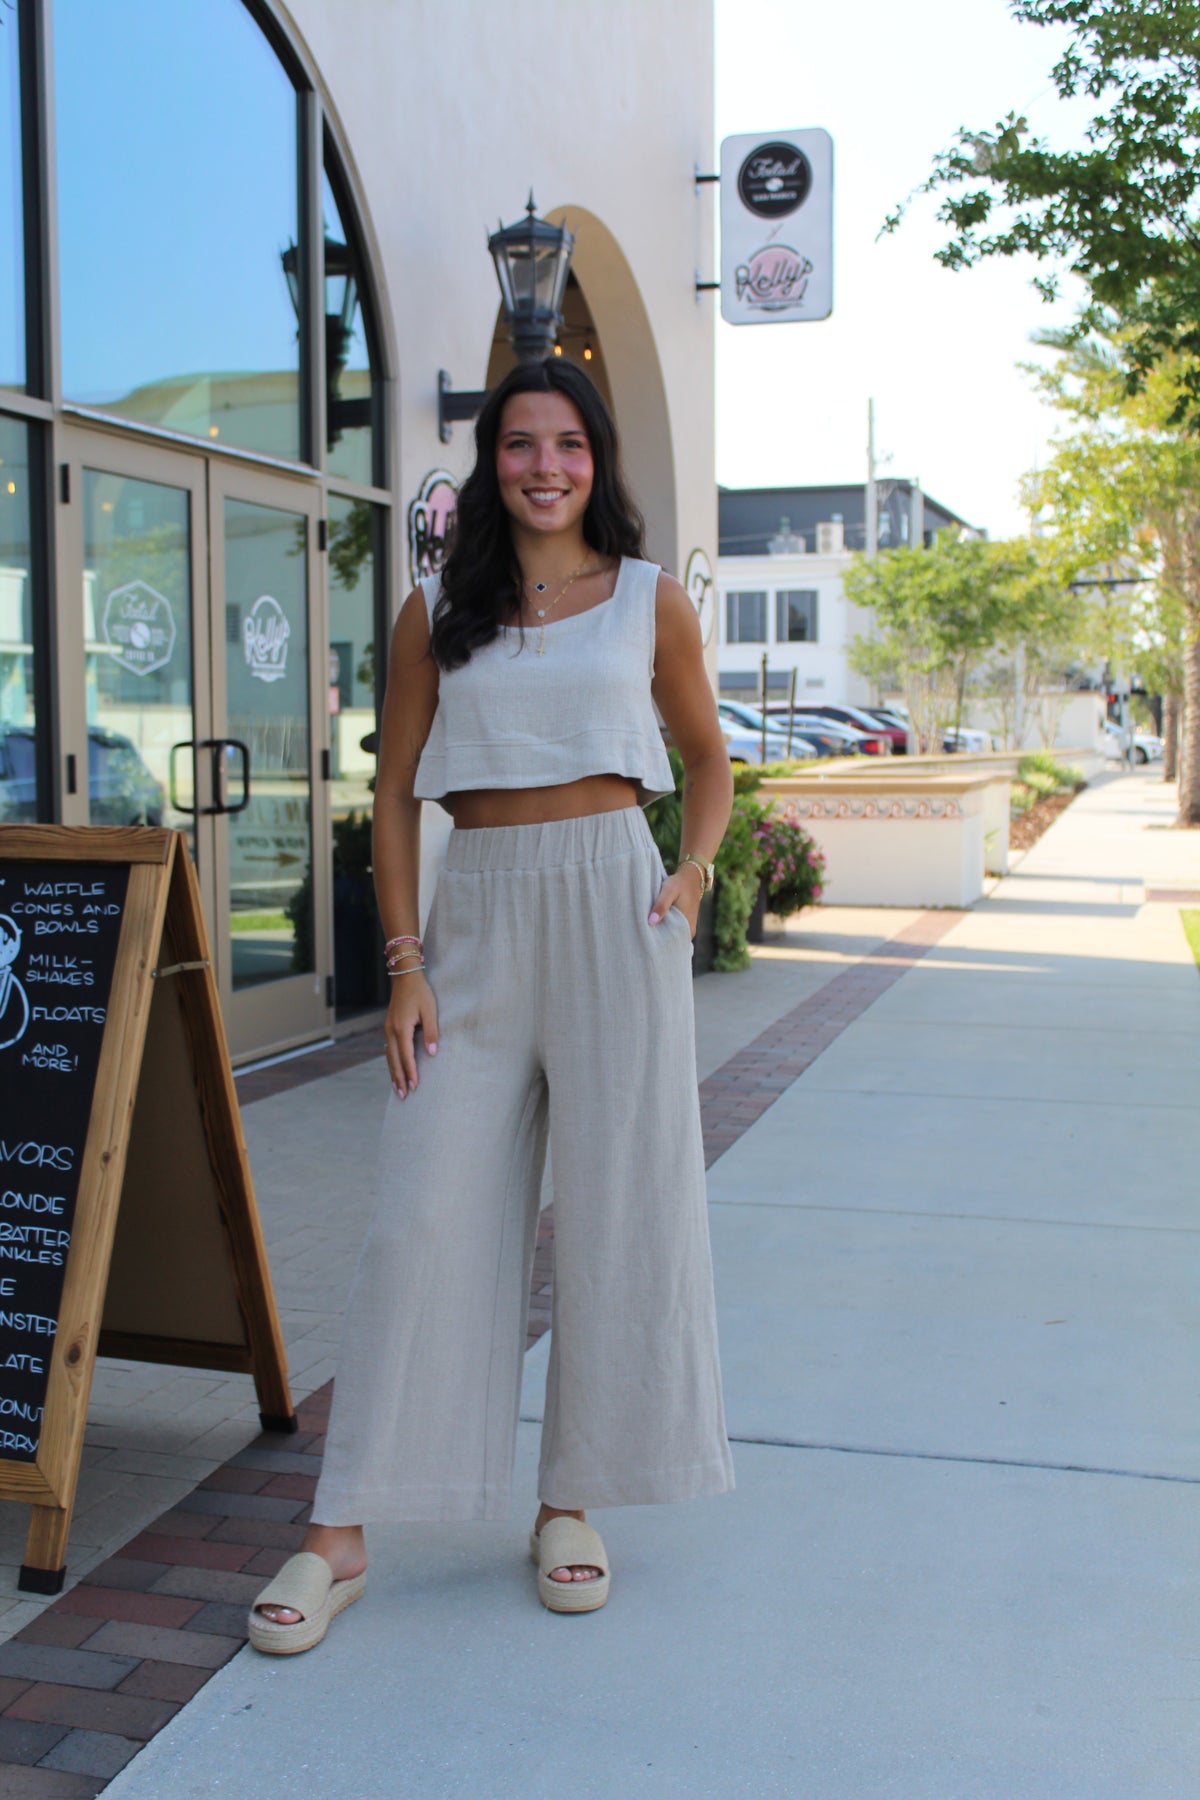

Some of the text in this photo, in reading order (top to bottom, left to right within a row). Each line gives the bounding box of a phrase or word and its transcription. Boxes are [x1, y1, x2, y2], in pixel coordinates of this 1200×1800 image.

[23, 882, 106, 897] WAFFLE
[10, 902, 121, 916] CONES AND
[34, 920, 100, 935] BOWLS
[28, 953, 93, 969] MILK-
[24, 971, 95, 986] SHAKES
[31, 1006, 106, 1024] FLOATS
[31, 1043, 69, 1057] AND
[21, 1054, 79, 1072] MORE!
[0, 1140, 75, 1171] VORS
[0, 1190, 66, 1215] ONDIE
[0, 1222, 71, 1249] BATTER
[0, 1353, 44, 1374] ATE
[0, 1396, 45, 1425] ONUT
